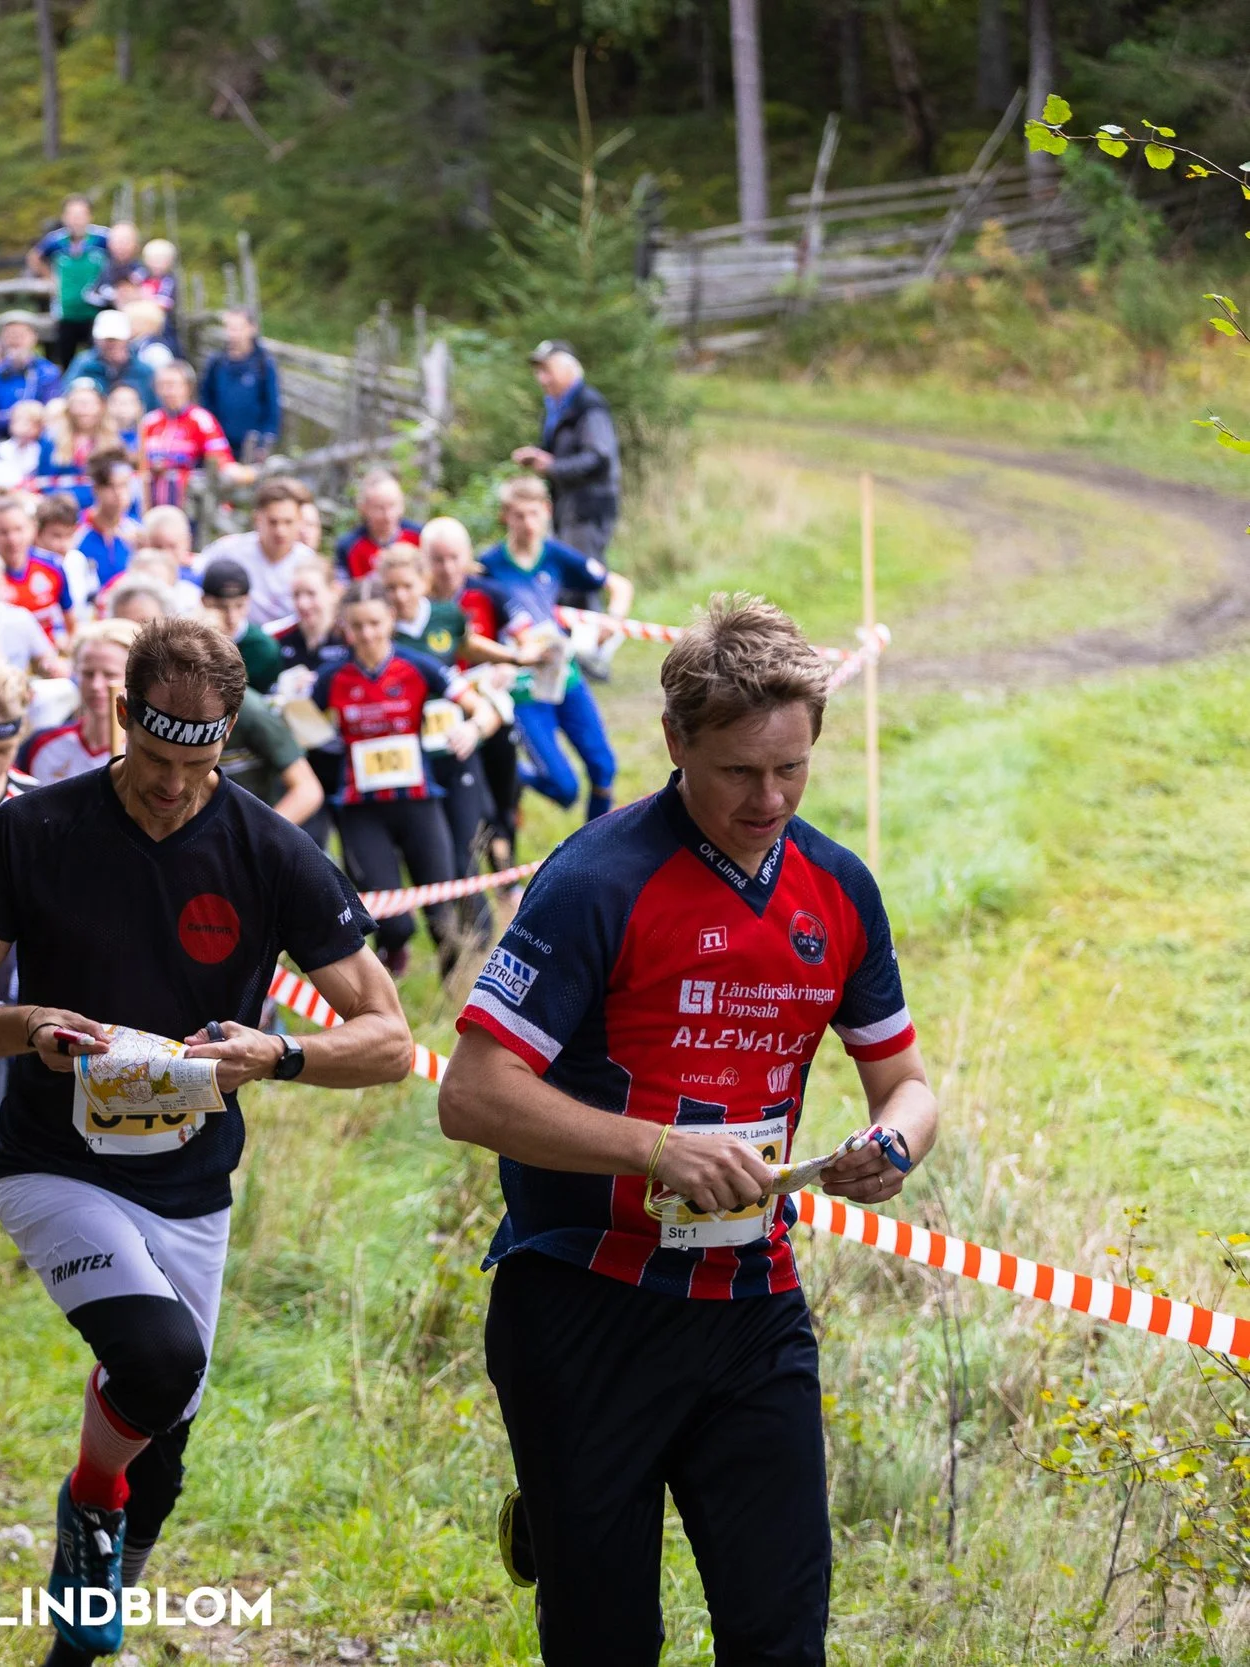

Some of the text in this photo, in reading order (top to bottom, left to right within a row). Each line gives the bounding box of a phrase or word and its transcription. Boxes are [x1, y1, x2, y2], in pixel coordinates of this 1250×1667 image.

[700, 843, 748, 890] OK Linné
[759, 837, 782, 885] UPPSALA
[719, 982, 835, 1006] Länsförsäkringar
[718, 1000, 779, 1018] Uppsala
[668, 1227, 697, 1239] Str 1
[51, 1253, 114, 1286] TRIMTEX
